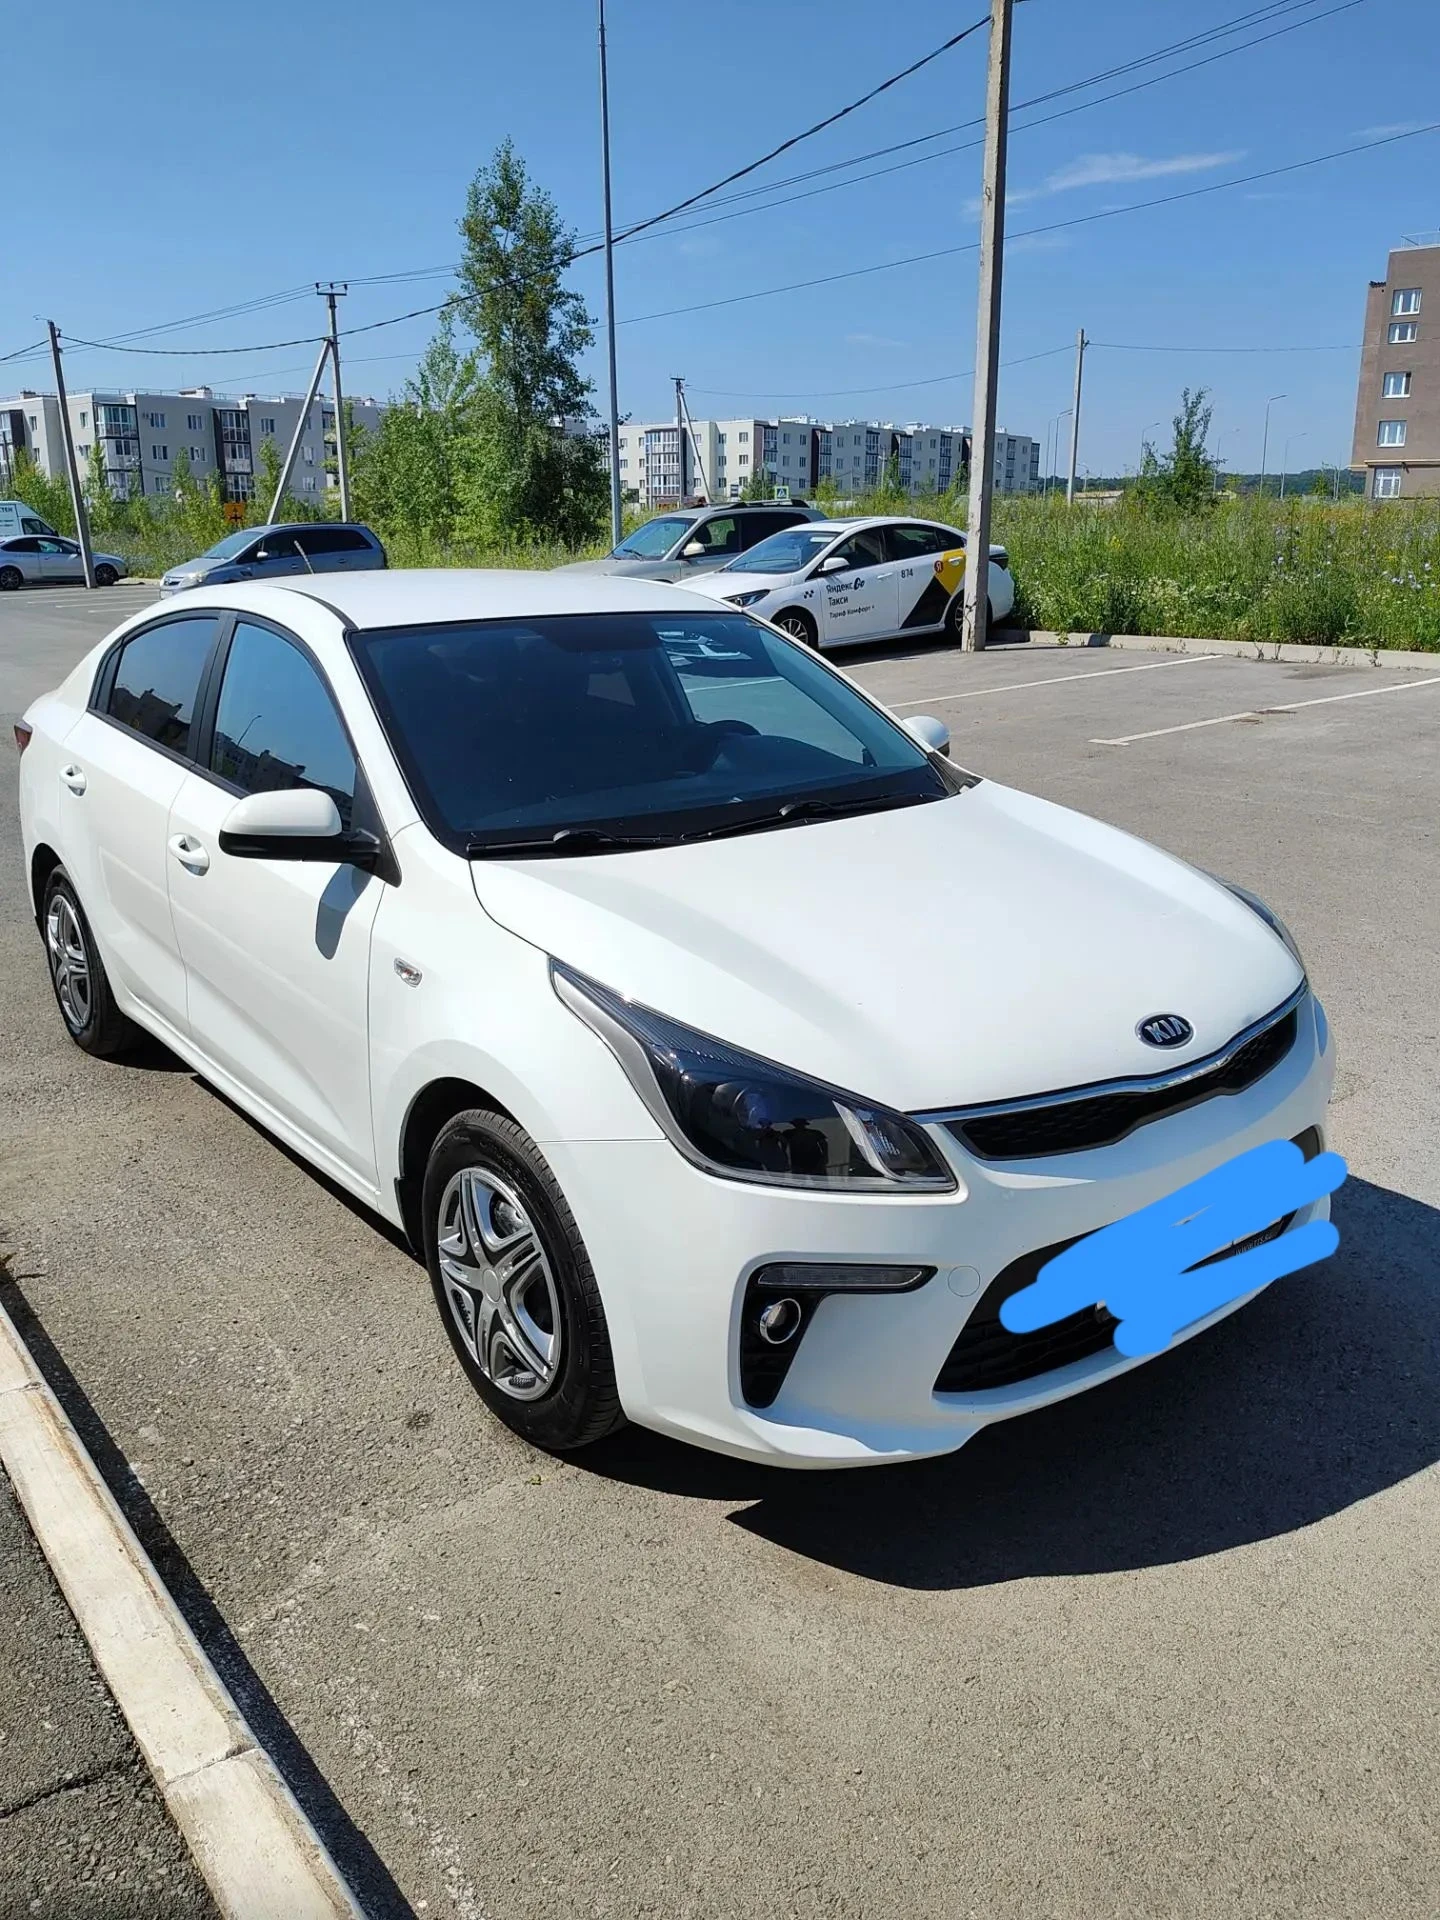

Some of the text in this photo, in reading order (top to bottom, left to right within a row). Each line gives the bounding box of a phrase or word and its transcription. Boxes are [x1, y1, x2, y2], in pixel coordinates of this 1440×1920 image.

[901, 568, 913, 578] 874
[826, 577, 865, 594] Яндекс Go
[828, 596, 848, 606] Такси
[829, 610, 846, 619] Тариф
[848, 605, 871, 615] Комфорт
[1144, 1016, 1190, 1043] KIA
